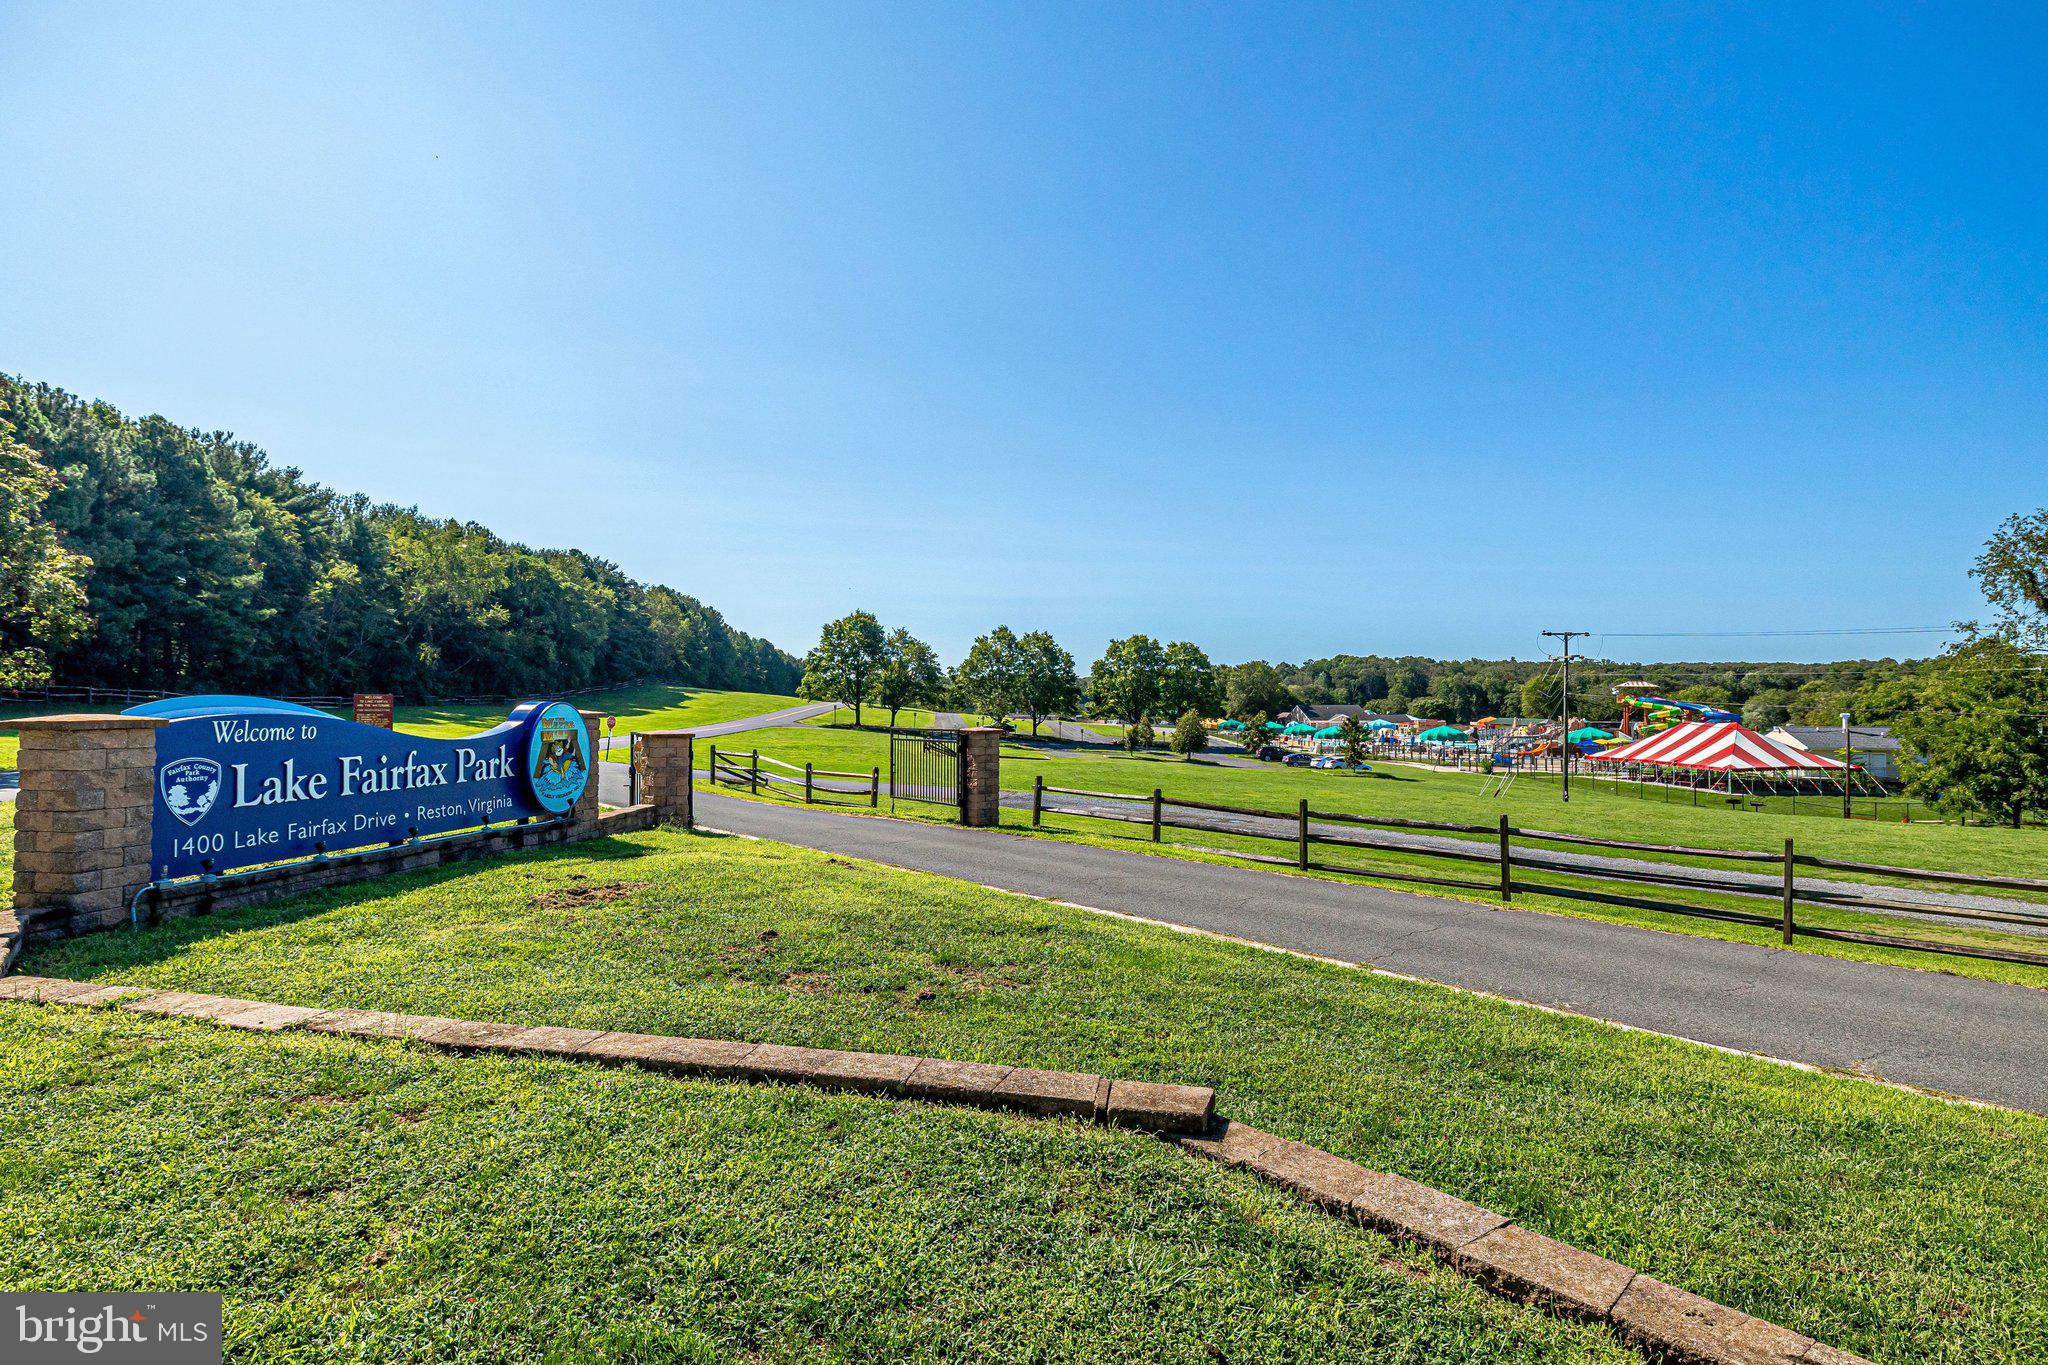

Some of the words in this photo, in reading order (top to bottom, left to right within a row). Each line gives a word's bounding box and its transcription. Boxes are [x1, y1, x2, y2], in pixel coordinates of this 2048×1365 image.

[212, 719, 296, 743] Welcome
[300, 724, 318, 742] to
[167, 764, 191, 776] Fairfax
[193, 763, 217, 774] County
[176, 775, 209, 783] Authority
[231, 757, 328, 808] Lake
[339, 750, 448, 797] Fairfax
[455, 744, 515, 784] Park
[173, 833, 224, 858] 1400
[234, 827, 279, 849] Lake
[288, 818, 347, 841] Fairfax
[353, 811, 397, 832] Drive
[417, 805, 467, 821] Reston,
[467, 796, 513, 815] Virginia
